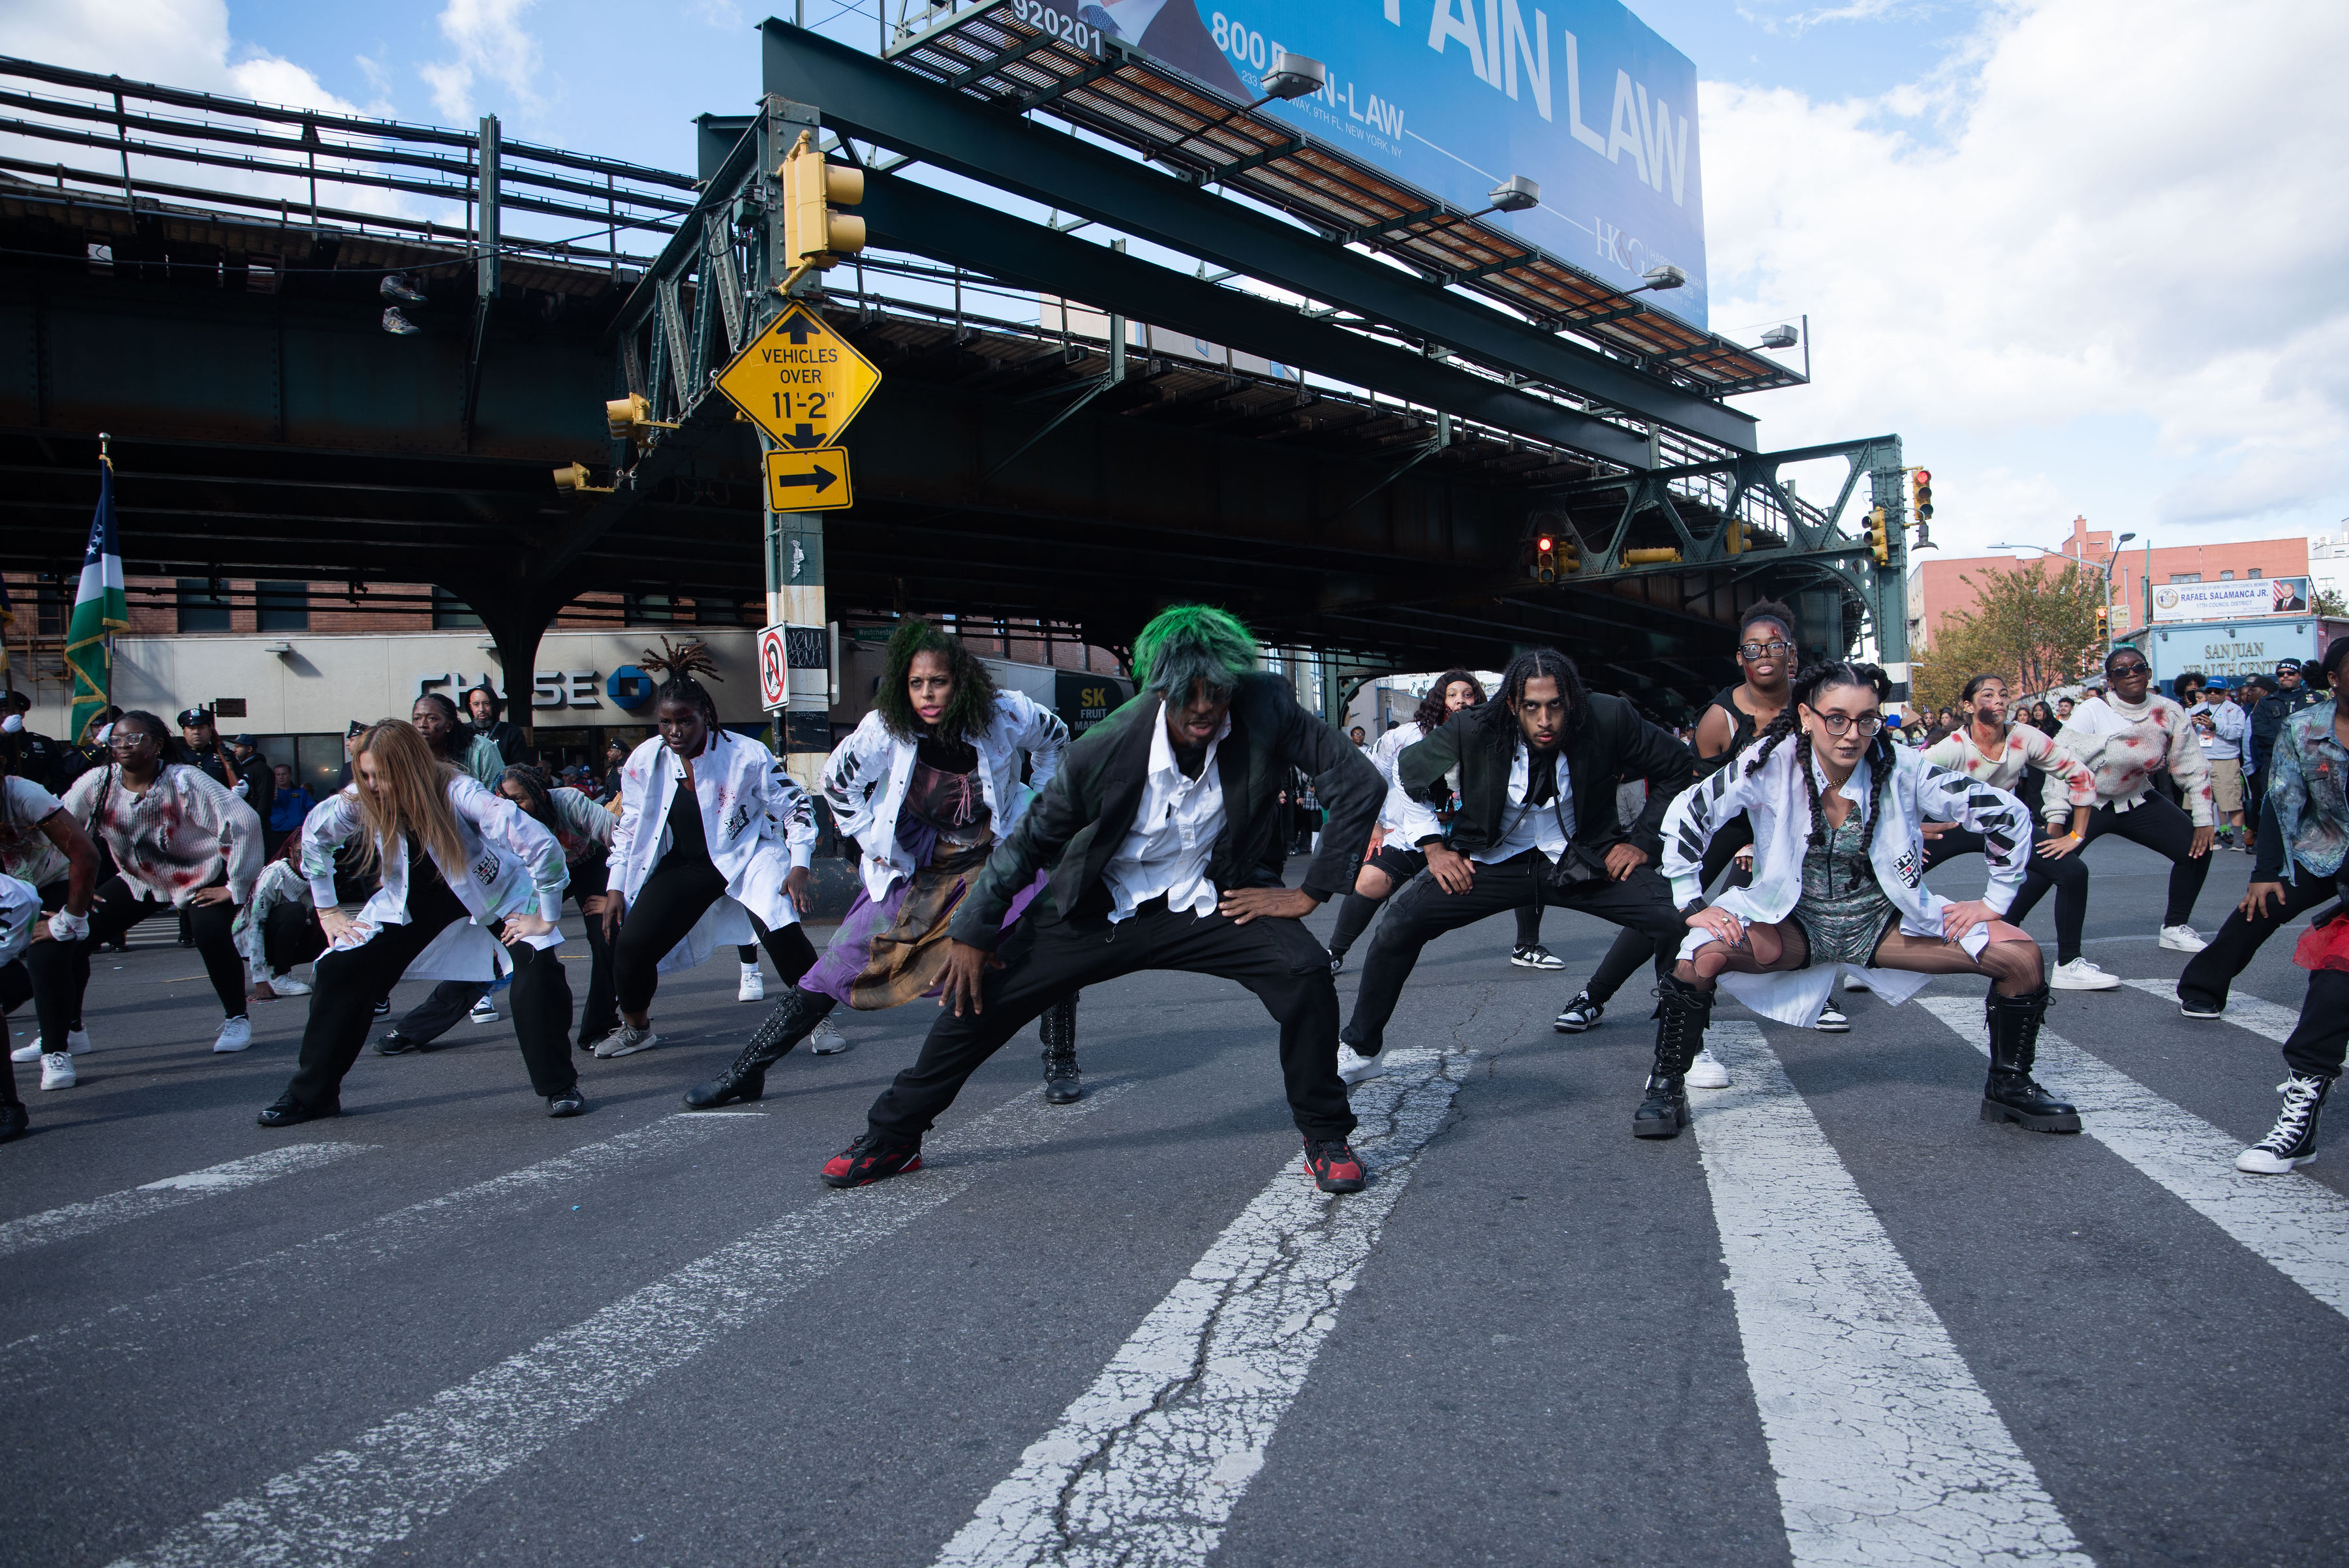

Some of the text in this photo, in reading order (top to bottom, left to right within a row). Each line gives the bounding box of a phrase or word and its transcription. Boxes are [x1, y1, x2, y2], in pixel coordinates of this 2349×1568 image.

[1013, 0, 1100, 56] 920201
[1212, 12, 1265, 70] 800
[1272, 40, 1404, 141] PN-LAW
[1242, 70, 1402, 158] 233 9TH FL, NEW YORK, NY
[1384, 0, 1688, 208] AIN LAW
[761, 348, 838, 364] VEHICLES
[780, 369, 821, 384] OVER
[773, 392, 835, 419] 11'-2"
[2181, 592, 2208, 601] RAFAEL
[2210, 590, 2255, 600] SALAMANCA
[2205, 642, 2264, 661] SAN JUAN
[2183, 660, 2281, 677] HEALTH CENT
[414, 670, 598, 707] CHSE
[1081, 687, 1106, 707] SK
[1080, 708, 1107, 719] FRUIT
[473, 850, 491, 873] THE
[482, 859, 498, 885] PKG
[1899, 858, 1917, 876] TOTA
[1903, 867, 1920, 888] PK
